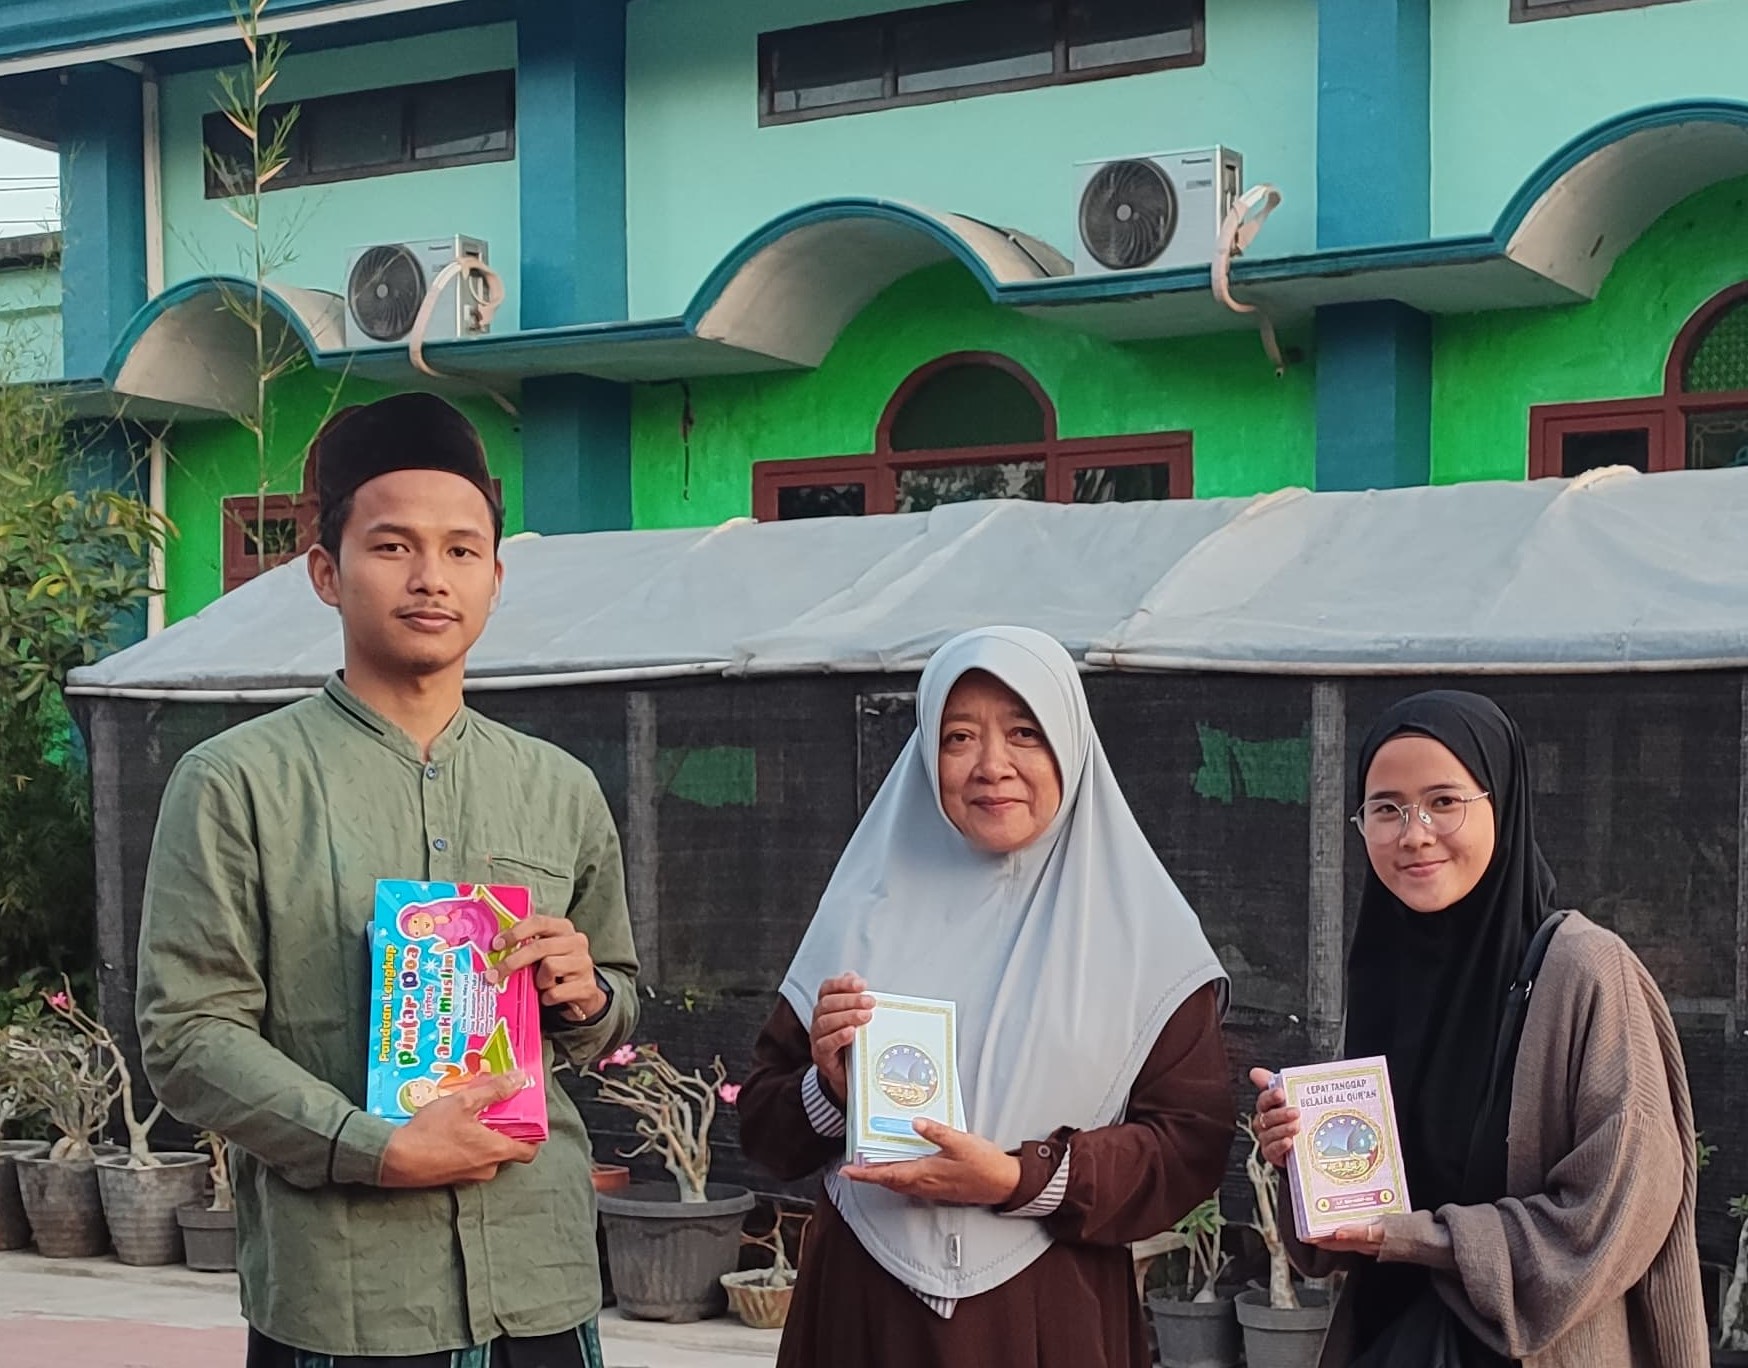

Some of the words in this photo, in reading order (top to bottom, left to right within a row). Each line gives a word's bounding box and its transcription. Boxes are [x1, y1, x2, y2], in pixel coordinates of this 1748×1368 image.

[382, 944, 398, 1001] Lengkap
[379, 1003, 393, 1062] Panduan
[396, 995, 419, 1066] Pintar
[1300, 1095, 1334, 1107] BELAJAR
[1336, 1094, 1346, 1103] AL
[1306, 1084, 1328, 1094] CEPAT
